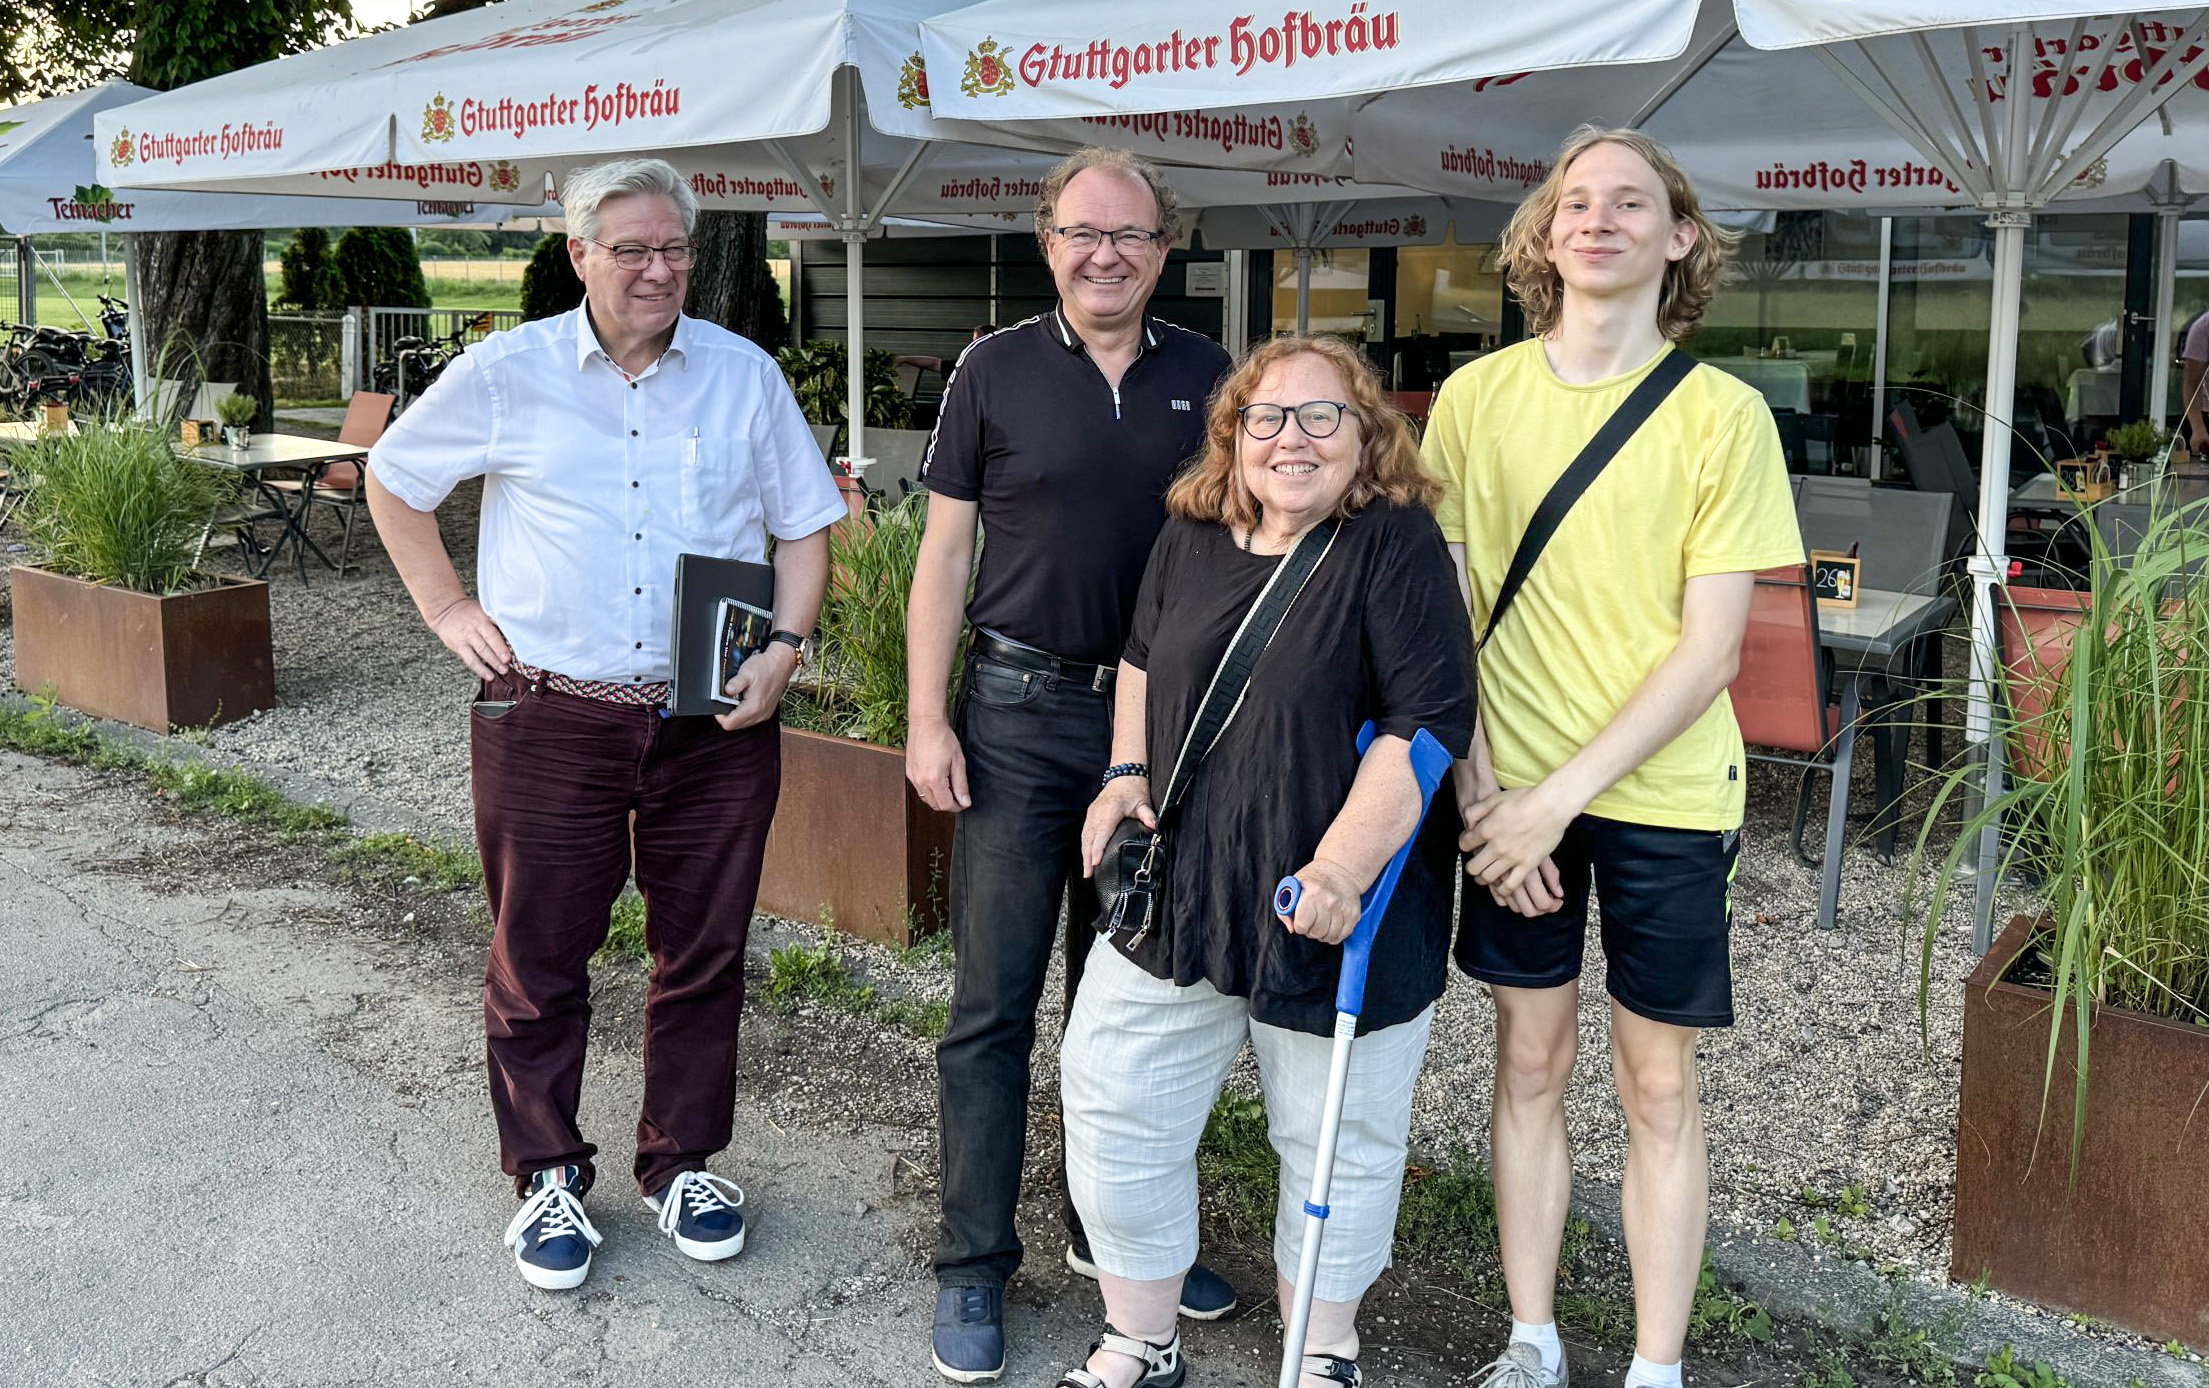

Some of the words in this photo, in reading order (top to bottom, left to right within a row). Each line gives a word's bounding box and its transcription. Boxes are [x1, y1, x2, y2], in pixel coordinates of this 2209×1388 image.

[1018, 29, 1221, 90] Stuttgarter
[1228, 1, 1400, 77] Hofbräu
[460, 93, 579, 140] Stuttgarter
[583, 79, 681, 132] Hofbräu
[139, 129, 218, 166] Stuttgarter
[220, 120, 283, 160] Hofbräu
[47, 197, 135, 221] Teinacher
[1816, 567, 1838, 588] 26
